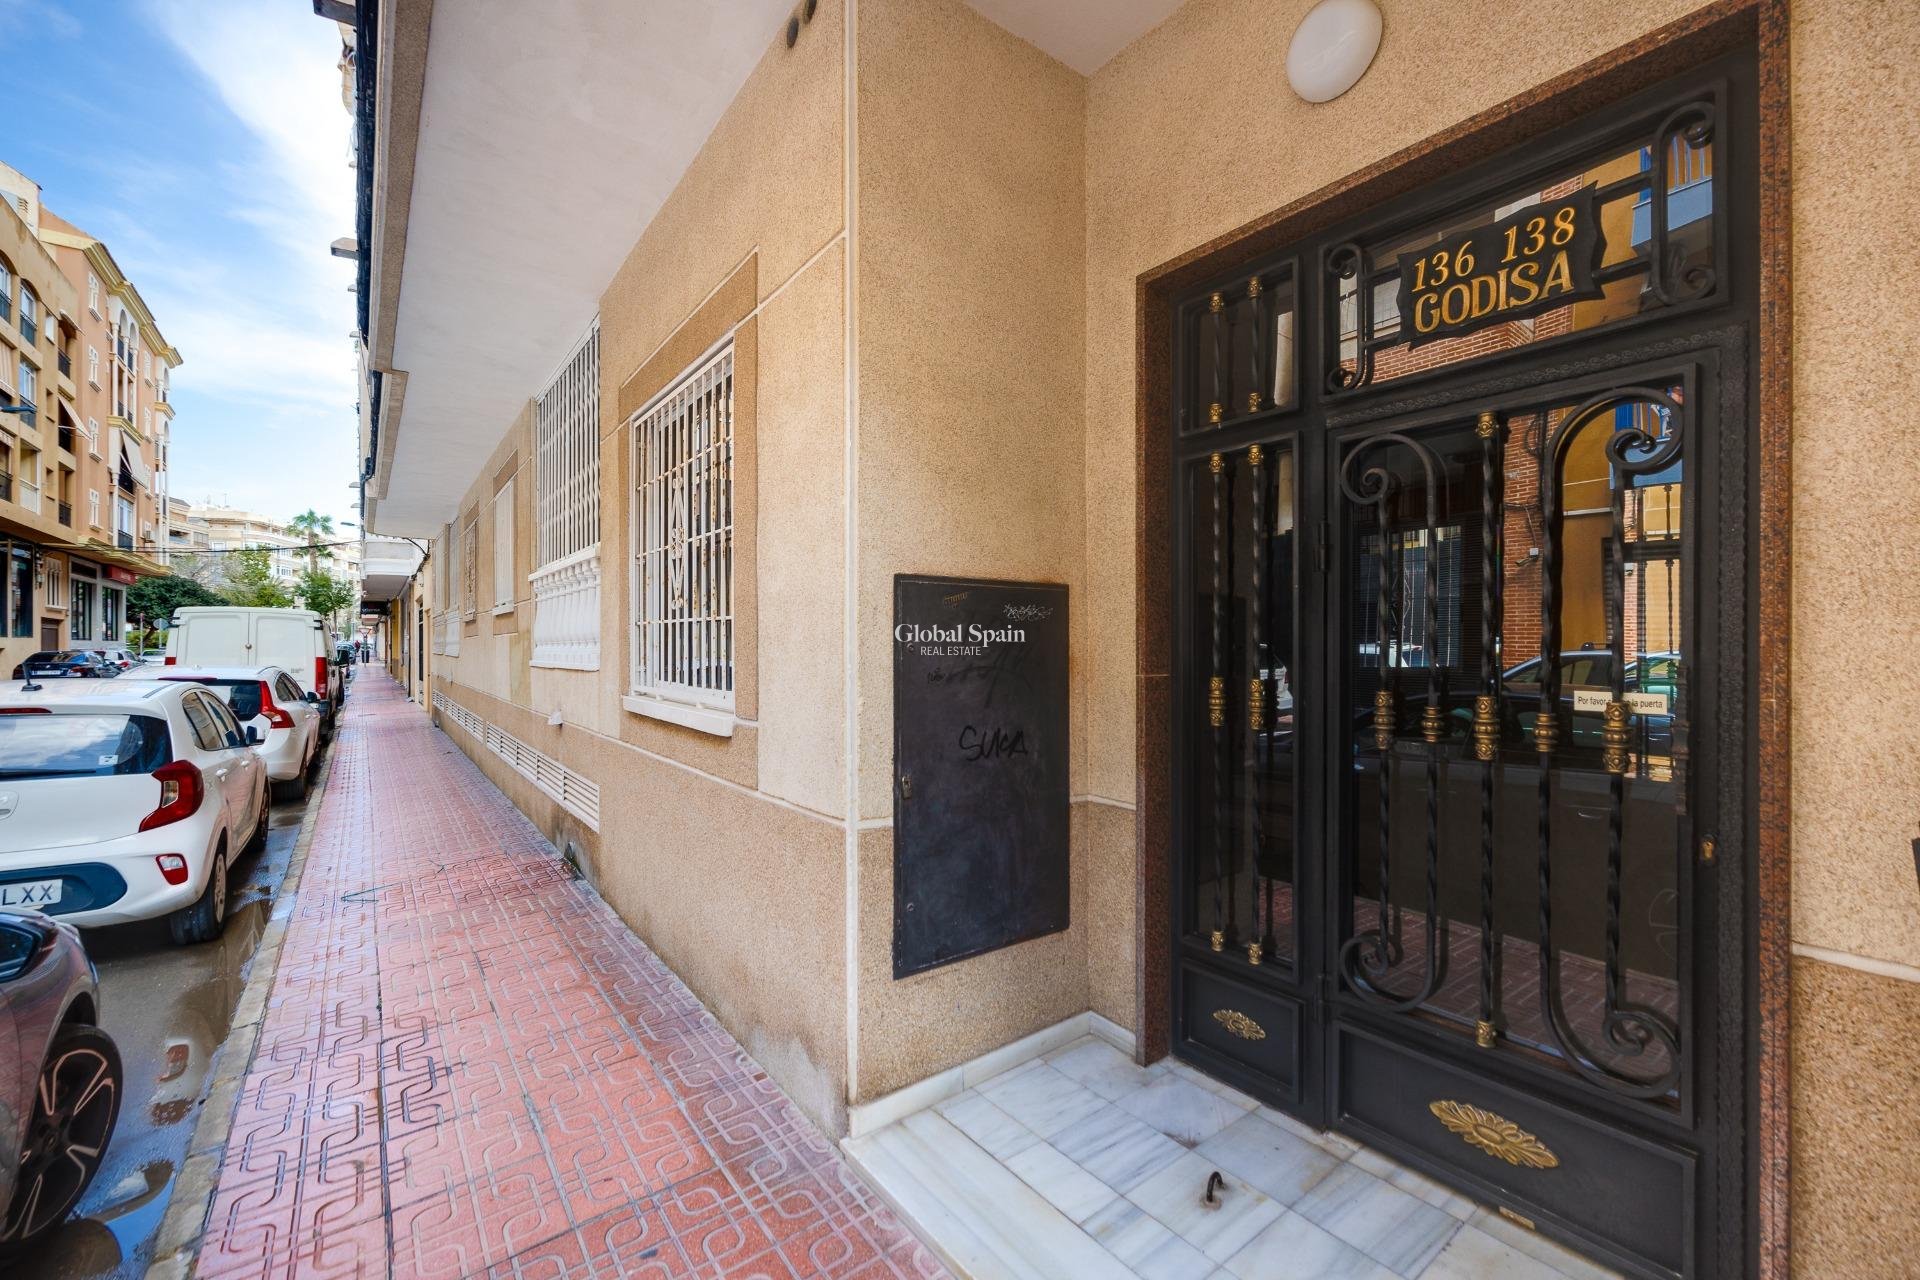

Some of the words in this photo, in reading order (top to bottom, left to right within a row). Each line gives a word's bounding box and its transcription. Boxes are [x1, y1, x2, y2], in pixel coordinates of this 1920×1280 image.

[1412, 240, 1476, 293] 136
[1501, 207, 1576, 264] 138
[1414, 250, 1575, 333] GODISA
[1578, 696, 1588, 705] Por
[1590, 696, 1606, 706] favor
[1640, 699, 1663, 710] puerta
[2, 884, 53, 906] LXX
